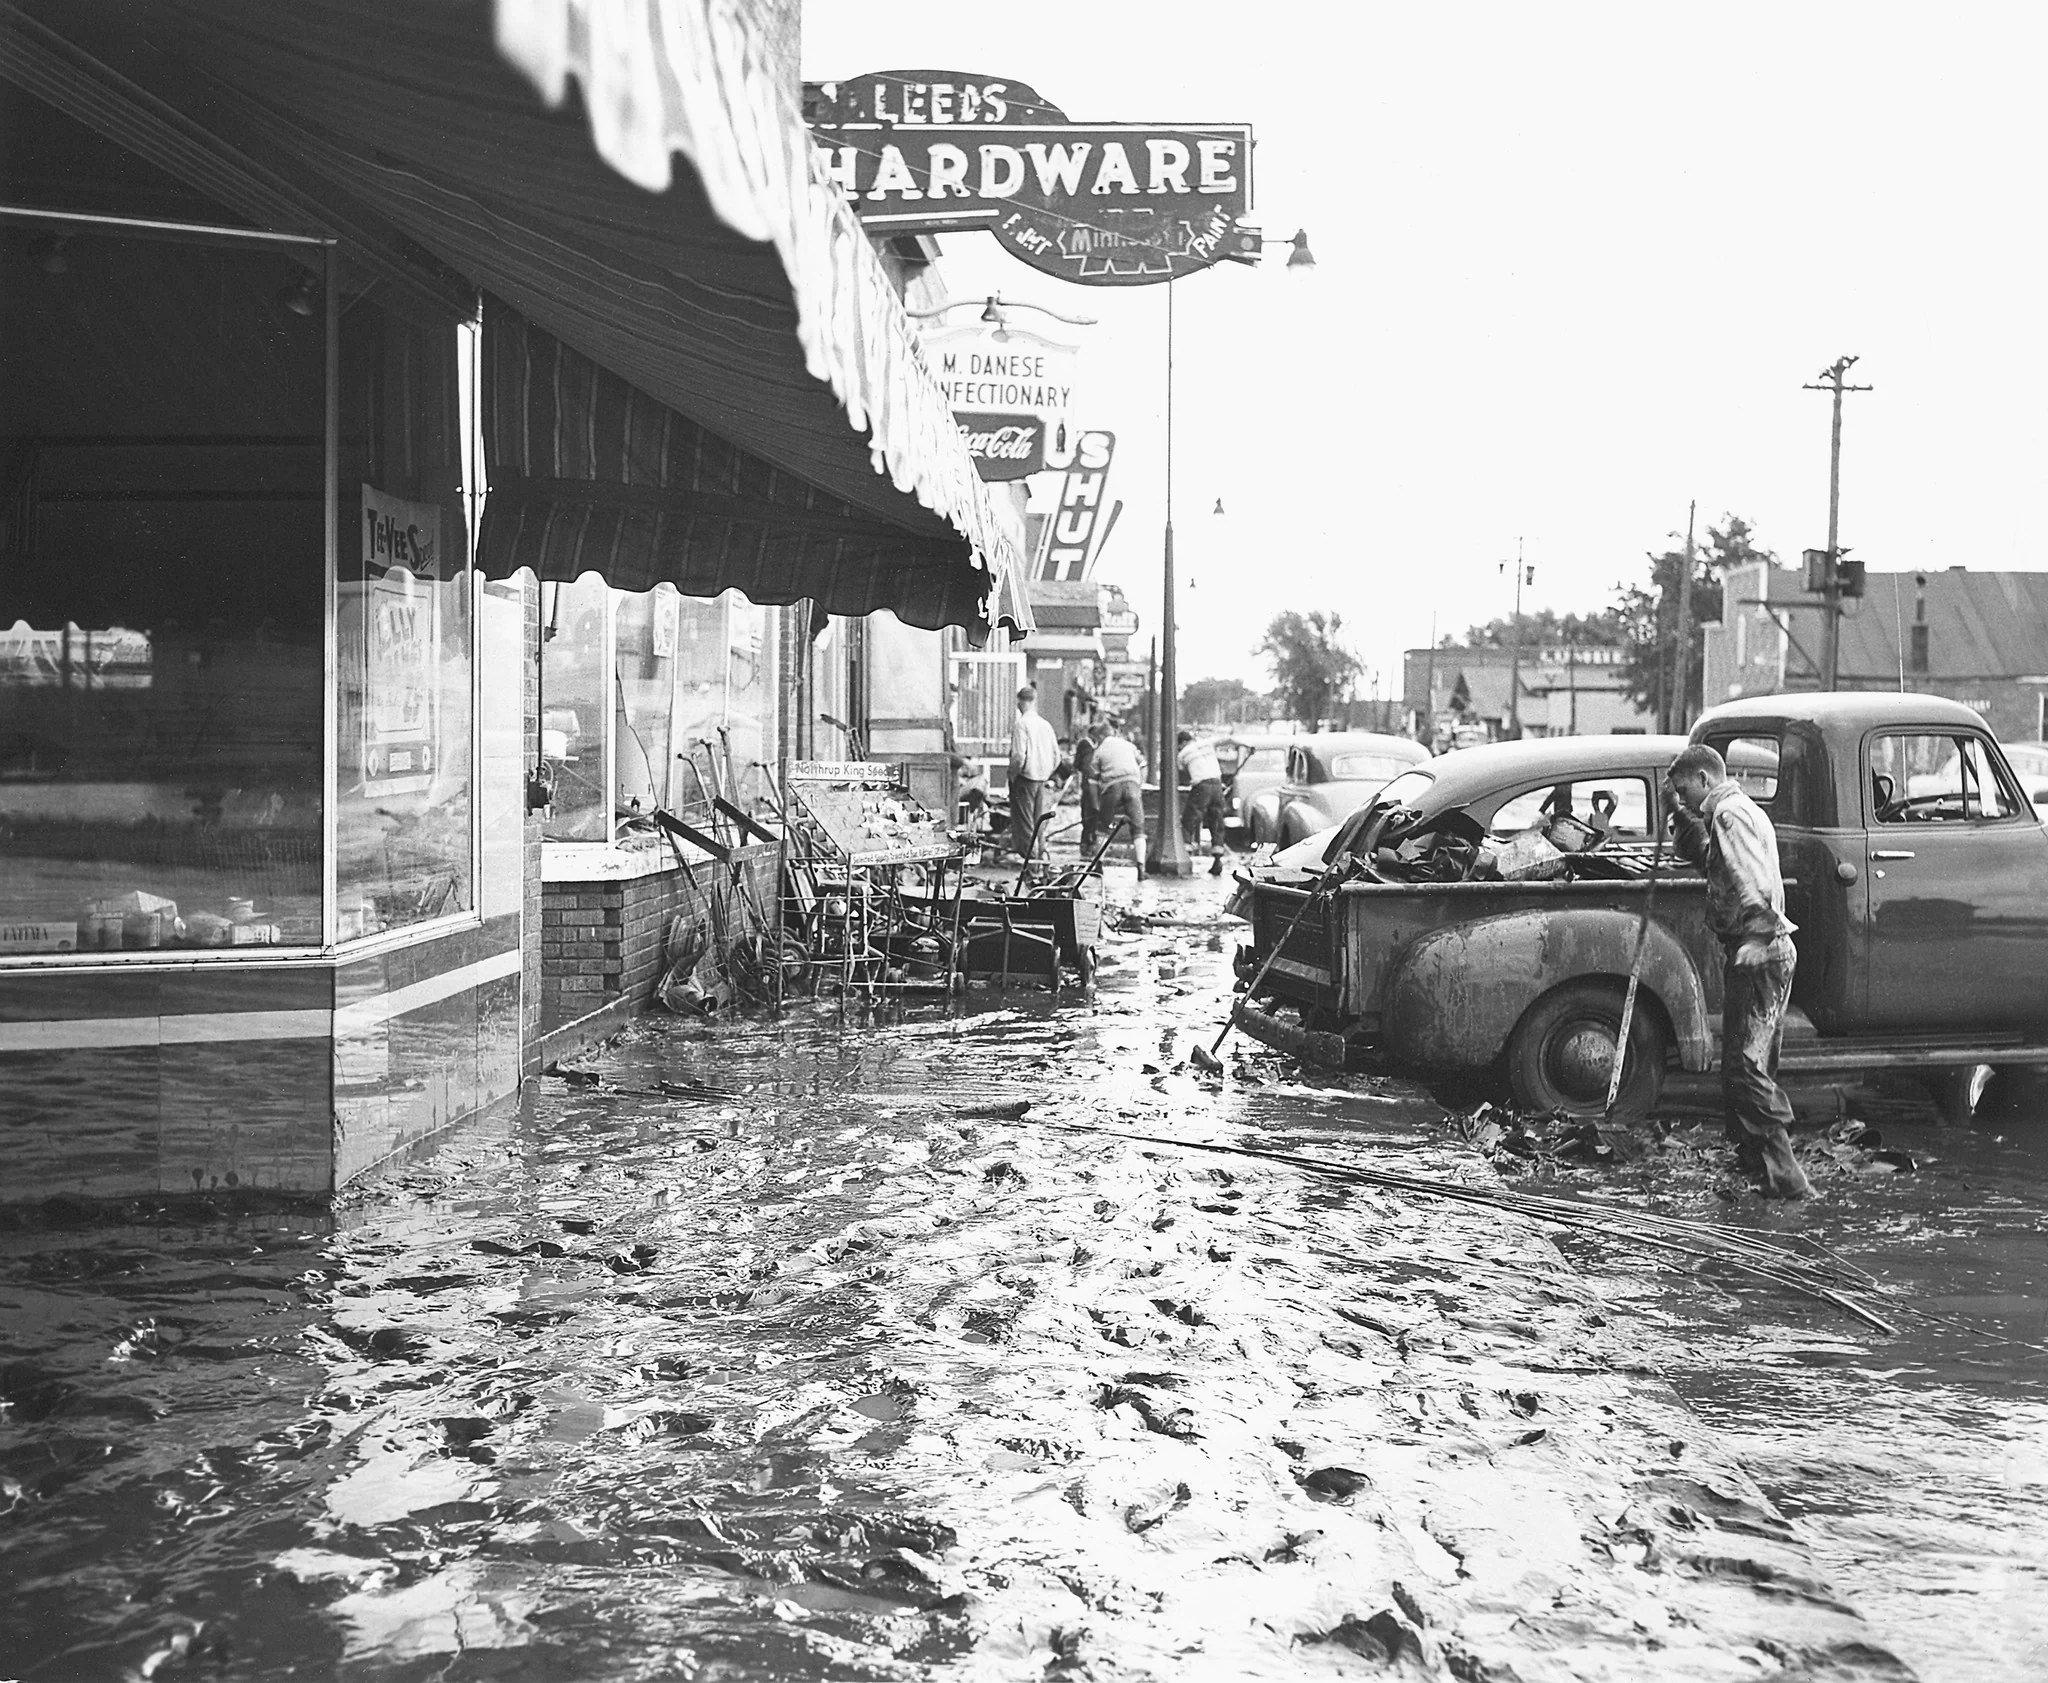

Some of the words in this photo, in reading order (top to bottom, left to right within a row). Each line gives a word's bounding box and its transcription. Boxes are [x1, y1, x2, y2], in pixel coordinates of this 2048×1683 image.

[874, 83, 1008, 123] LEEDS
[816, 139, 1238, 201] HARDWARE
[942, 352, 963, 375] M.
[971, 354, 1045, 378] DANESE
[796, 761, 841, 777] Northrup
[844, 764, 865, 778] King
